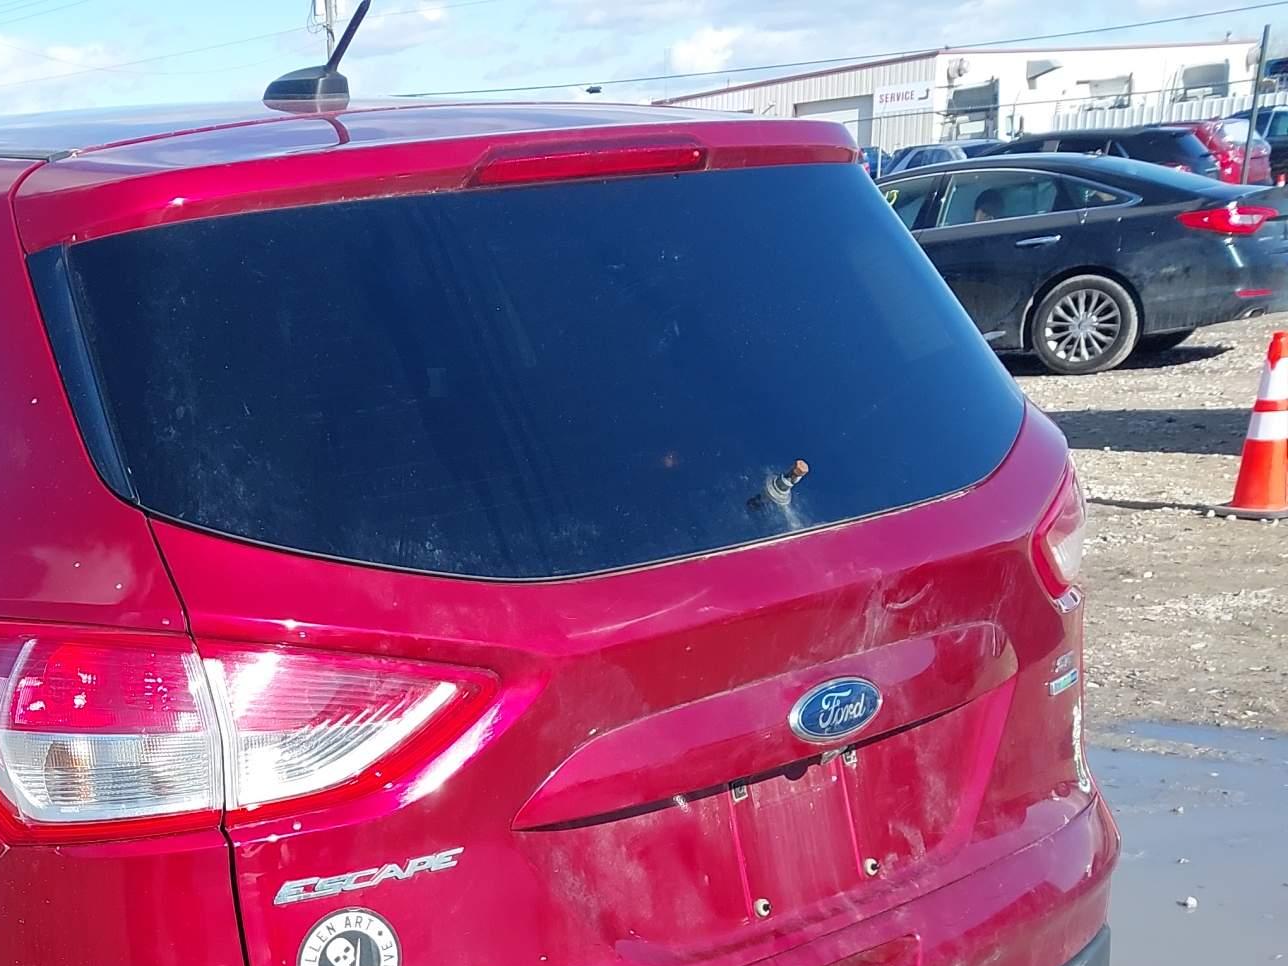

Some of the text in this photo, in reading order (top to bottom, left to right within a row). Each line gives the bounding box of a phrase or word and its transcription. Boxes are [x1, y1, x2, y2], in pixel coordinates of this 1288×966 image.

[879, 90, 914, 104] SERVICE
[818, 688, 867, 728] Ford
[273, 847, 464, 905] ESCAPE
[344, 915, 374, 930] ART
